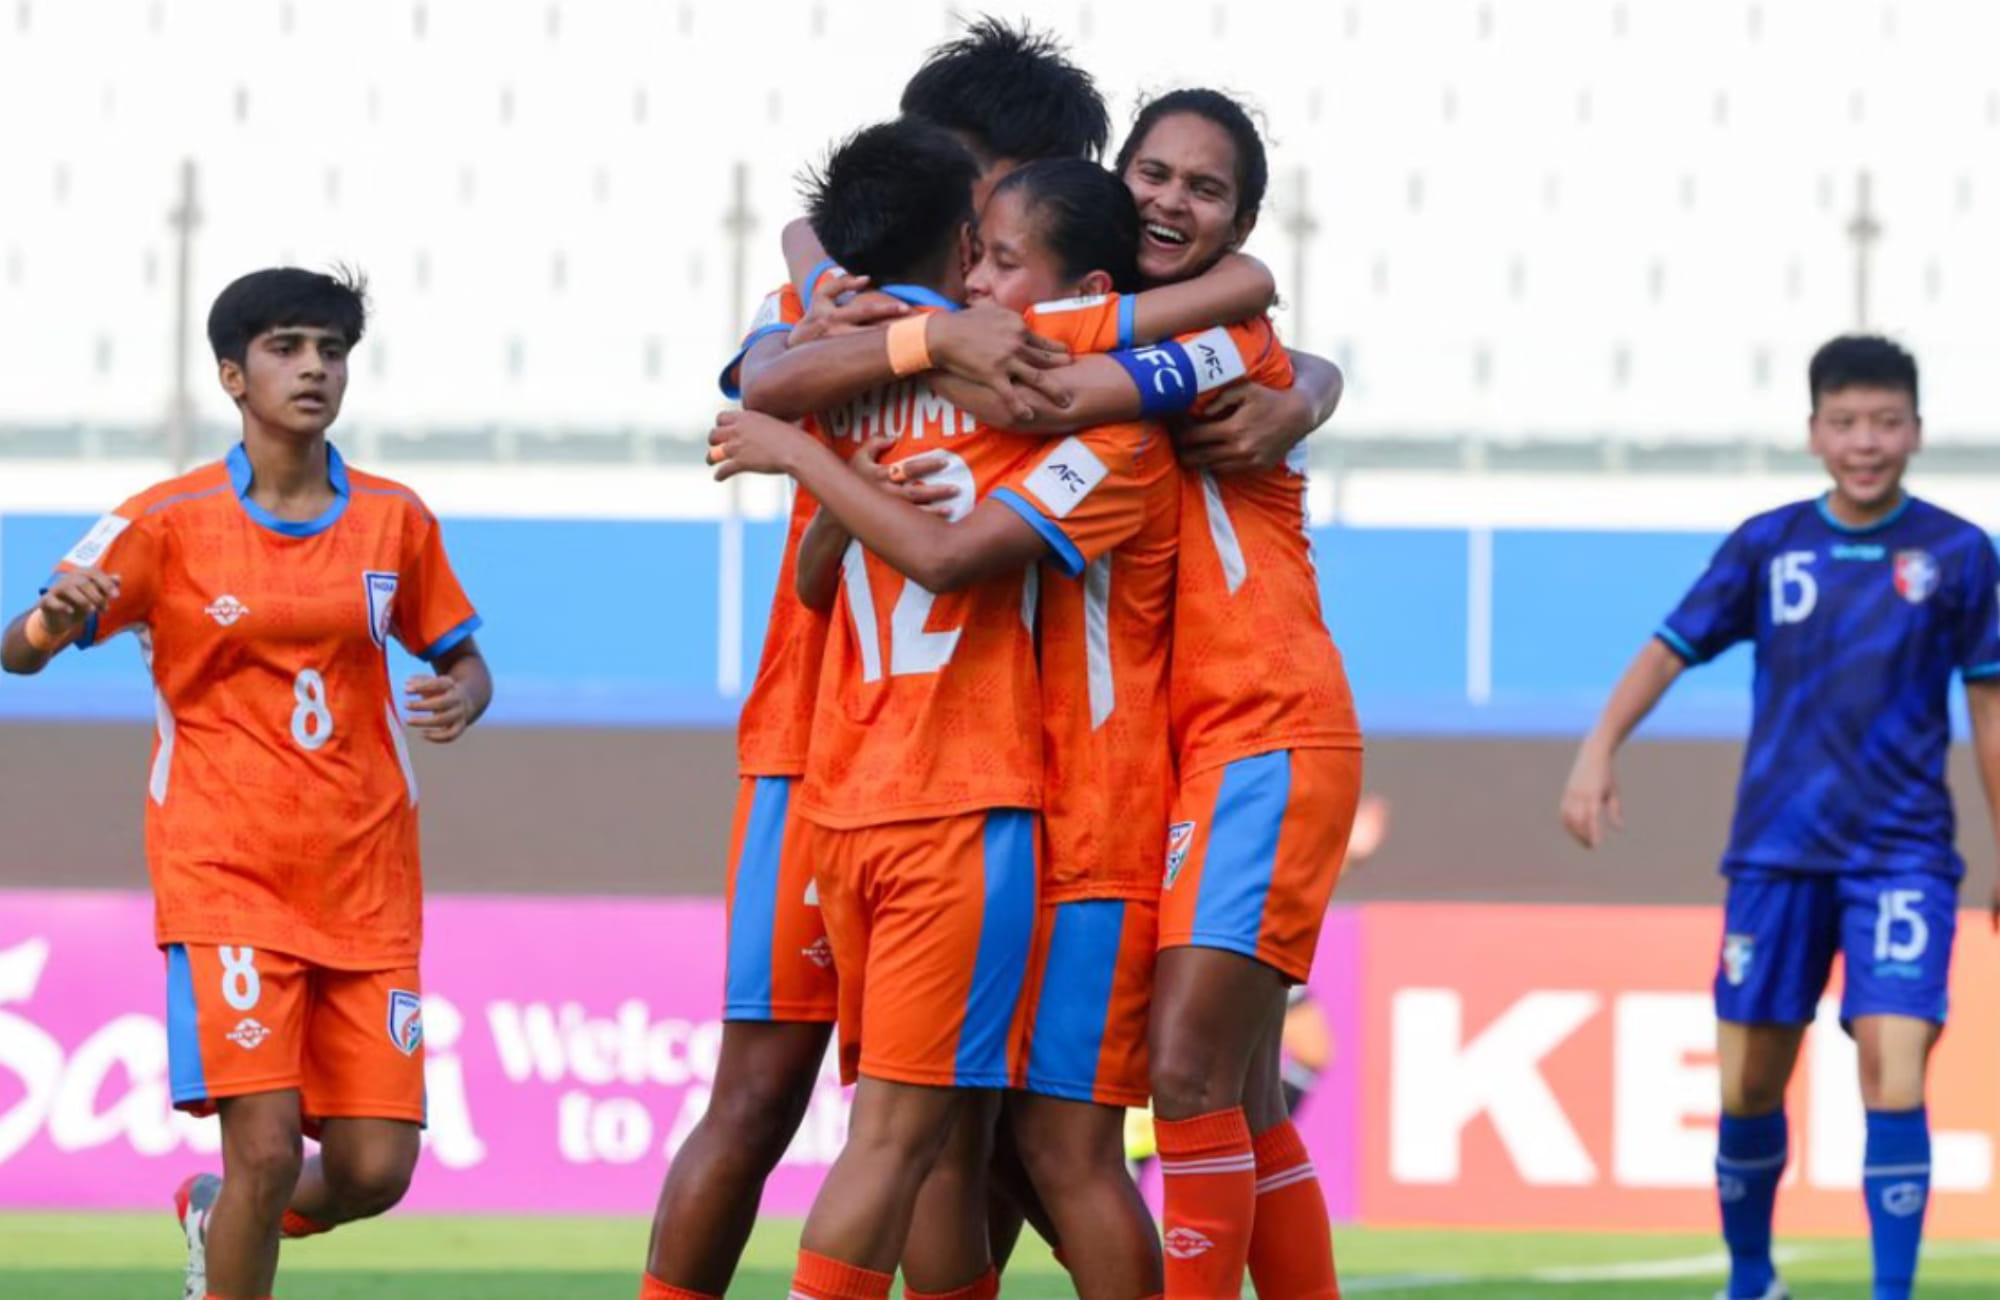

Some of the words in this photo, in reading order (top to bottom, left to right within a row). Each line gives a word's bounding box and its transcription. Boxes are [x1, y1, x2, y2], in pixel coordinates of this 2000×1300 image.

[1198, 344, 1223, 379] AFC
[1047, 464, 1086, 493] AFC
[842, 449, 976, 683] 12
[1769, 551, 1818, 625] 15
[291, 668, 333, 751] 8
[1874, 890, 1929, 960] 15
[219, 946, 261, 1011] 8
[557, 1090, 654, 1164] to
